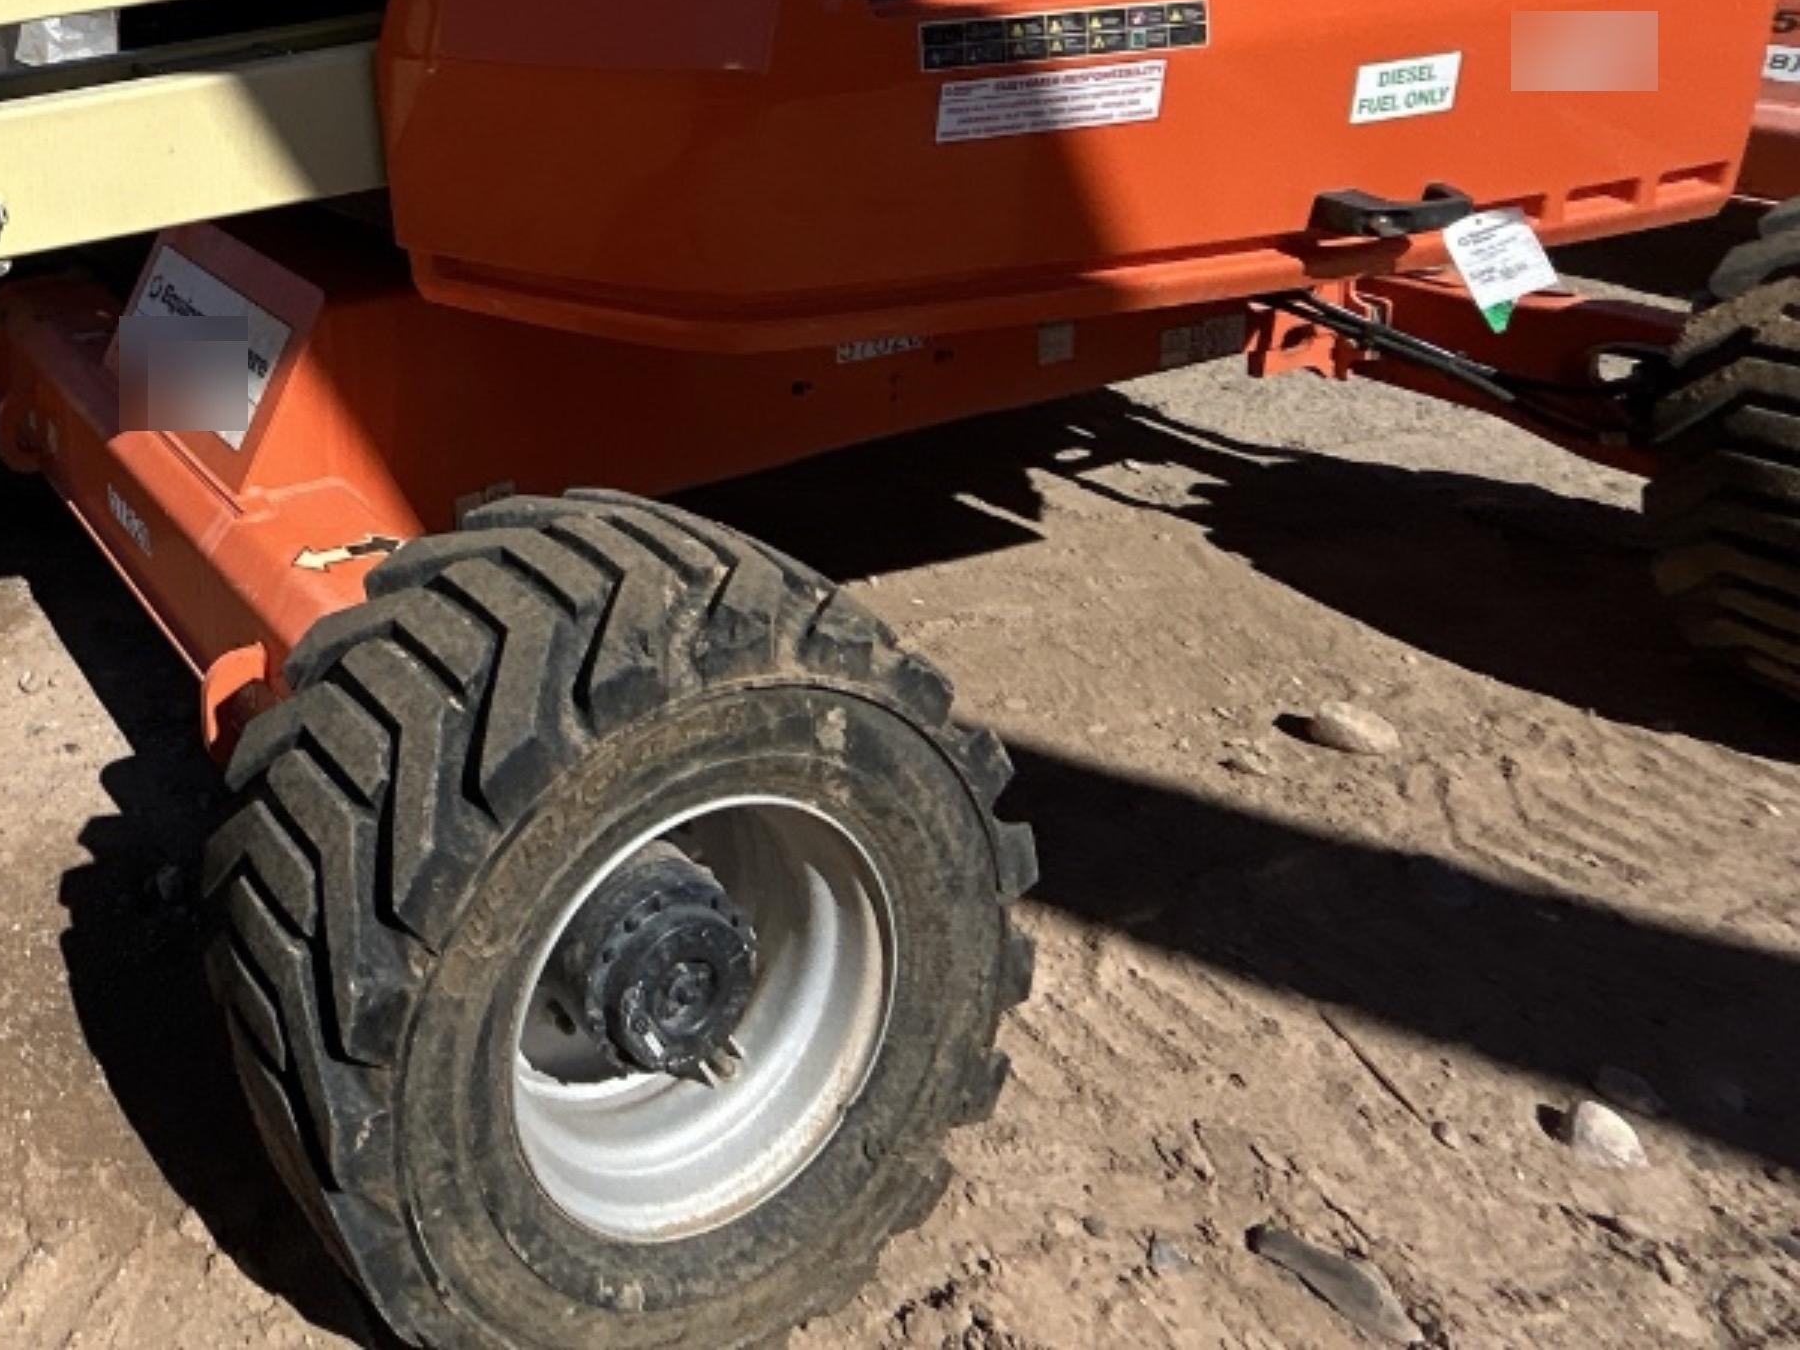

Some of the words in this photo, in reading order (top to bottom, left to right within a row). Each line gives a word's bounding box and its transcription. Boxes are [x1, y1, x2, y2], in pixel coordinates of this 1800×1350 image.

[1377, 63, 1437, 88] DIESEL
[1357, 94, 1400, 114] FUEL
[1404, 87, 1450, 109] ONLY
